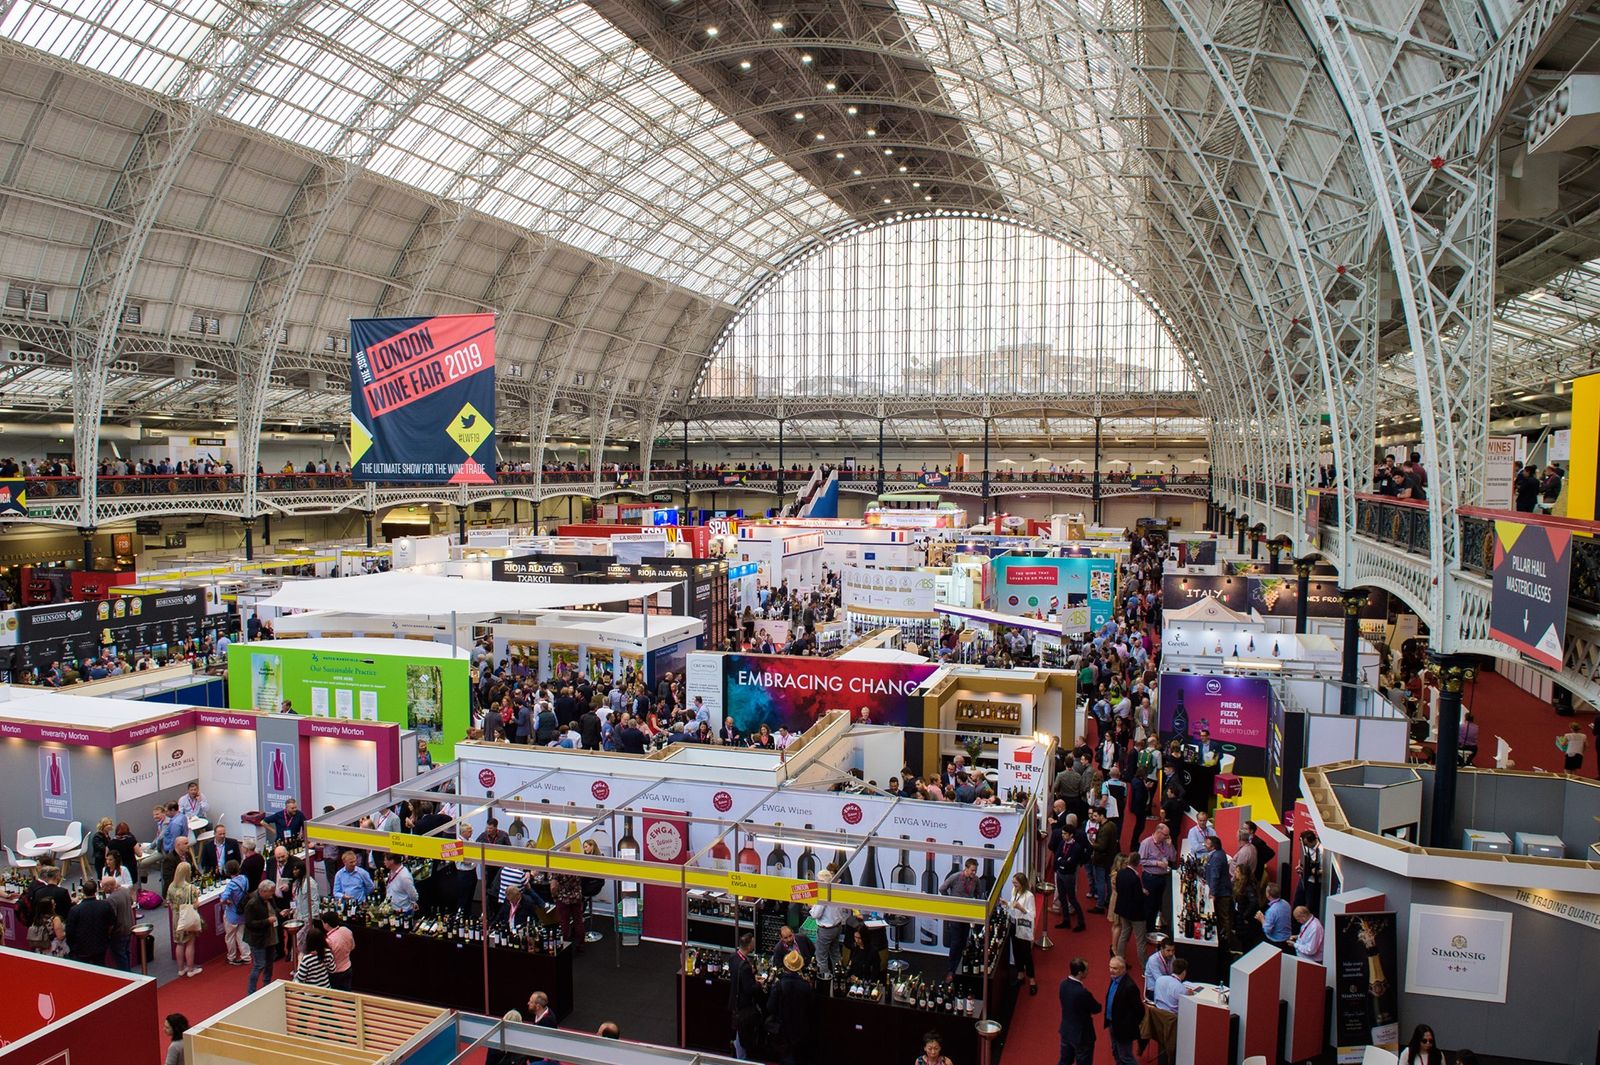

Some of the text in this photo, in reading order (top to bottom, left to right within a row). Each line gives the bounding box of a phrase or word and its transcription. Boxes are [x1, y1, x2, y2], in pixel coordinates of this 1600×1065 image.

[371, 327, 434, 374] LONDON
[361, 369, 372, 384] THE
[368, 343, 482, 412] WINE FAIR 2019
[458, 433, 480, 443] #LWF19
[361, 463, 486, 474] THE ULTIMATE SHOW FOR THE WINE TRADE
[709, 521, 738, 534] SPAIN
[504, 563, 564, 574] RIOJA ALAVESA
[1512, 555, 1547, 578] PILLAR HALL
[518, 575, 551, 583] TXAKOLI
[658, 570, 688, 578] ALAVESA
[1186, 589, 1224, 599] ITALY
[1506, 575, 1552, 604] MASTERCLASSES
[32, 612, 66, 624] ROBINSONS
[322, 666, 353, 674] Sustainable
[355, 668, 376, 676] Practice
[738, 670, 844, 692] EMBRACING
[849, 678, 920, 696] CHANG
[1220, 702, 1244, 710] FRESH,
[200, 714, 250, 726] Inverarity Morton
[1220, 710, 1239, 718] FIZZY,
[2, 724, 21, 734] Morton
[41, 728, 89, 740] Inverarity Morton
[130, 720, 180, 738] Inverarity Morton
[312, 724, 364, 736] Inverarity Morton
[161, 760, 182, 771] SACRED
[1004, 762, 1020, 770] The
[120, 771, 154, 787] AMISFIELD
[1016, 772, 1032, 780] Pot
[521, 780, 566, 792] EGA Wines
[45, 798, 68, 806] INVERARITY
[662, 795, 686, 804] Wines
[48, 806, 66, 814] MORTON
[762, 804, 812, 816] EWGA Wines
[894, 816, 948, 829] EWGA Wines
[650, 826, 673, 840] EWGA
[792, 884, 810, 892] LONDON
[1515, 890, 1532, 903] THE
[1532, 894, 1568, 914] TRADING
[1431, 946, 1486, 960] SIMONSIG
